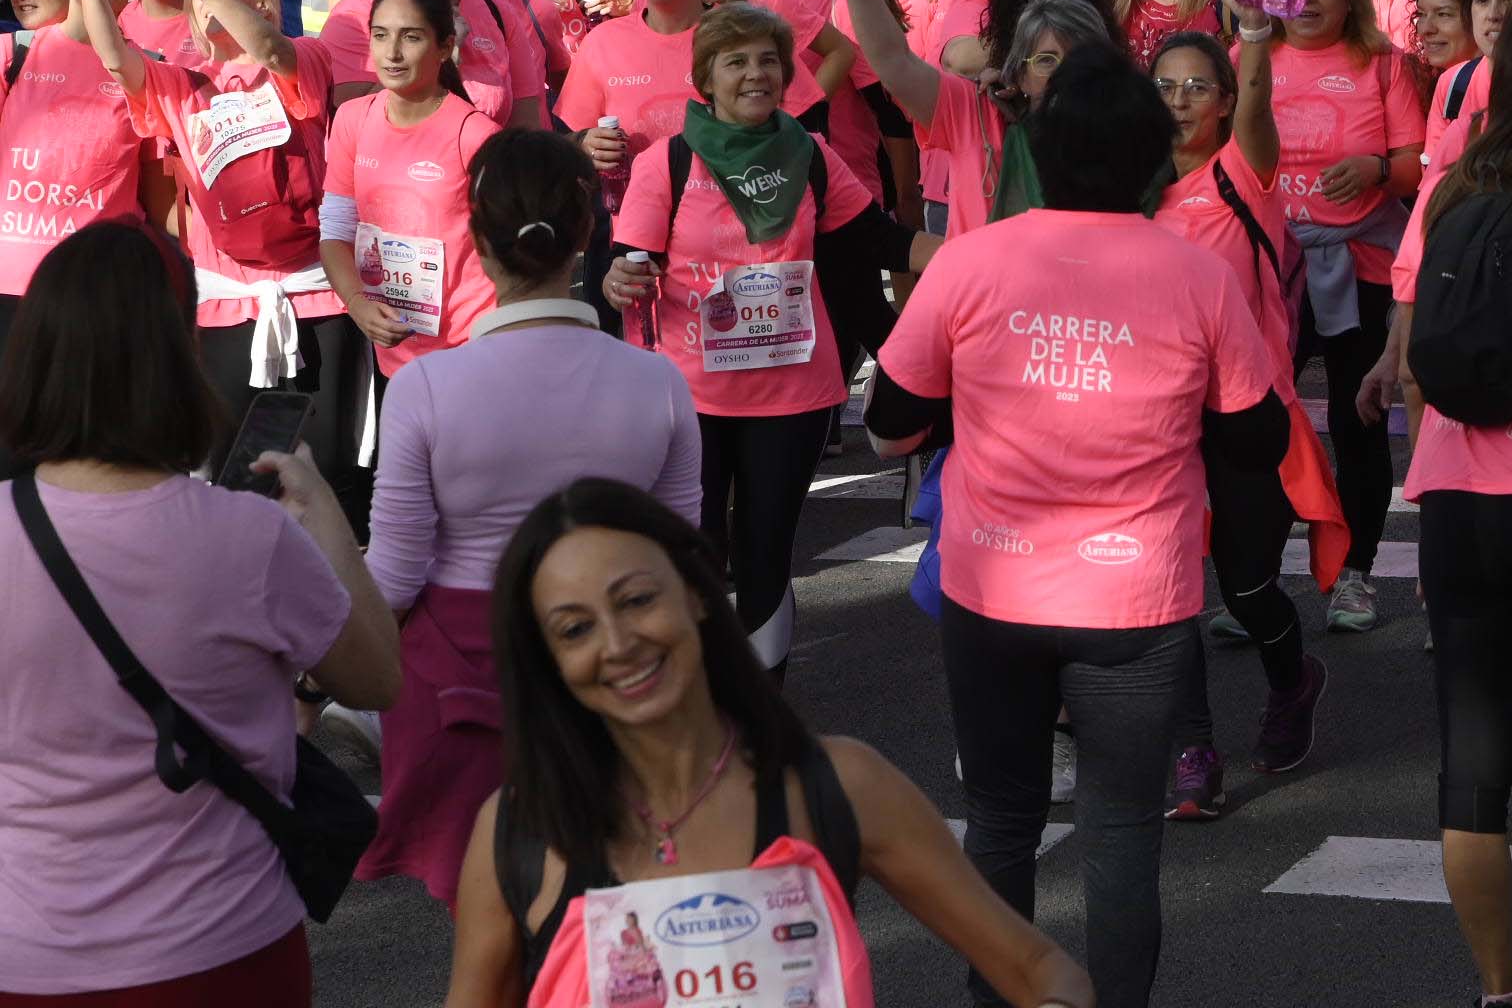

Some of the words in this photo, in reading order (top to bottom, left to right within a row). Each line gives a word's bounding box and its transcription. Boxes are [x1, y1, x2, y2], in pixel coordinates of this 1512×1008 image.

[214, 112, 246, 133] 016
[11, 148, 40, 170] TU
[687, 179, 720, 191] OYSH
[738, 169, 789, 199] WERK
[2, 211, 78, 238] SUMA
[383, 269, 413, 286] 016
[735, 281, 780, 293] ASTURIANA
[385, 287, 409, 298] 25942
[740, 304, 780, 321] 016
[748, 323, 773, 334] 6280
[1009, 310, 1135, 346] CARRERA
[716, 339, 747, 348] CARRERA
[776, 346, 809, 359] Santander
[1030, 338, 1064, 363] DE
[1075, 342, 1108, 368] LA
[714, 353, 750, 364] OYSHO
[1022, 360, 1112, 393] MUJER
[972, 528, 1034, 555] OYSHO
[664, 912, 752, 938] ASTURIANA
[675, 961, 758, 998] 016
